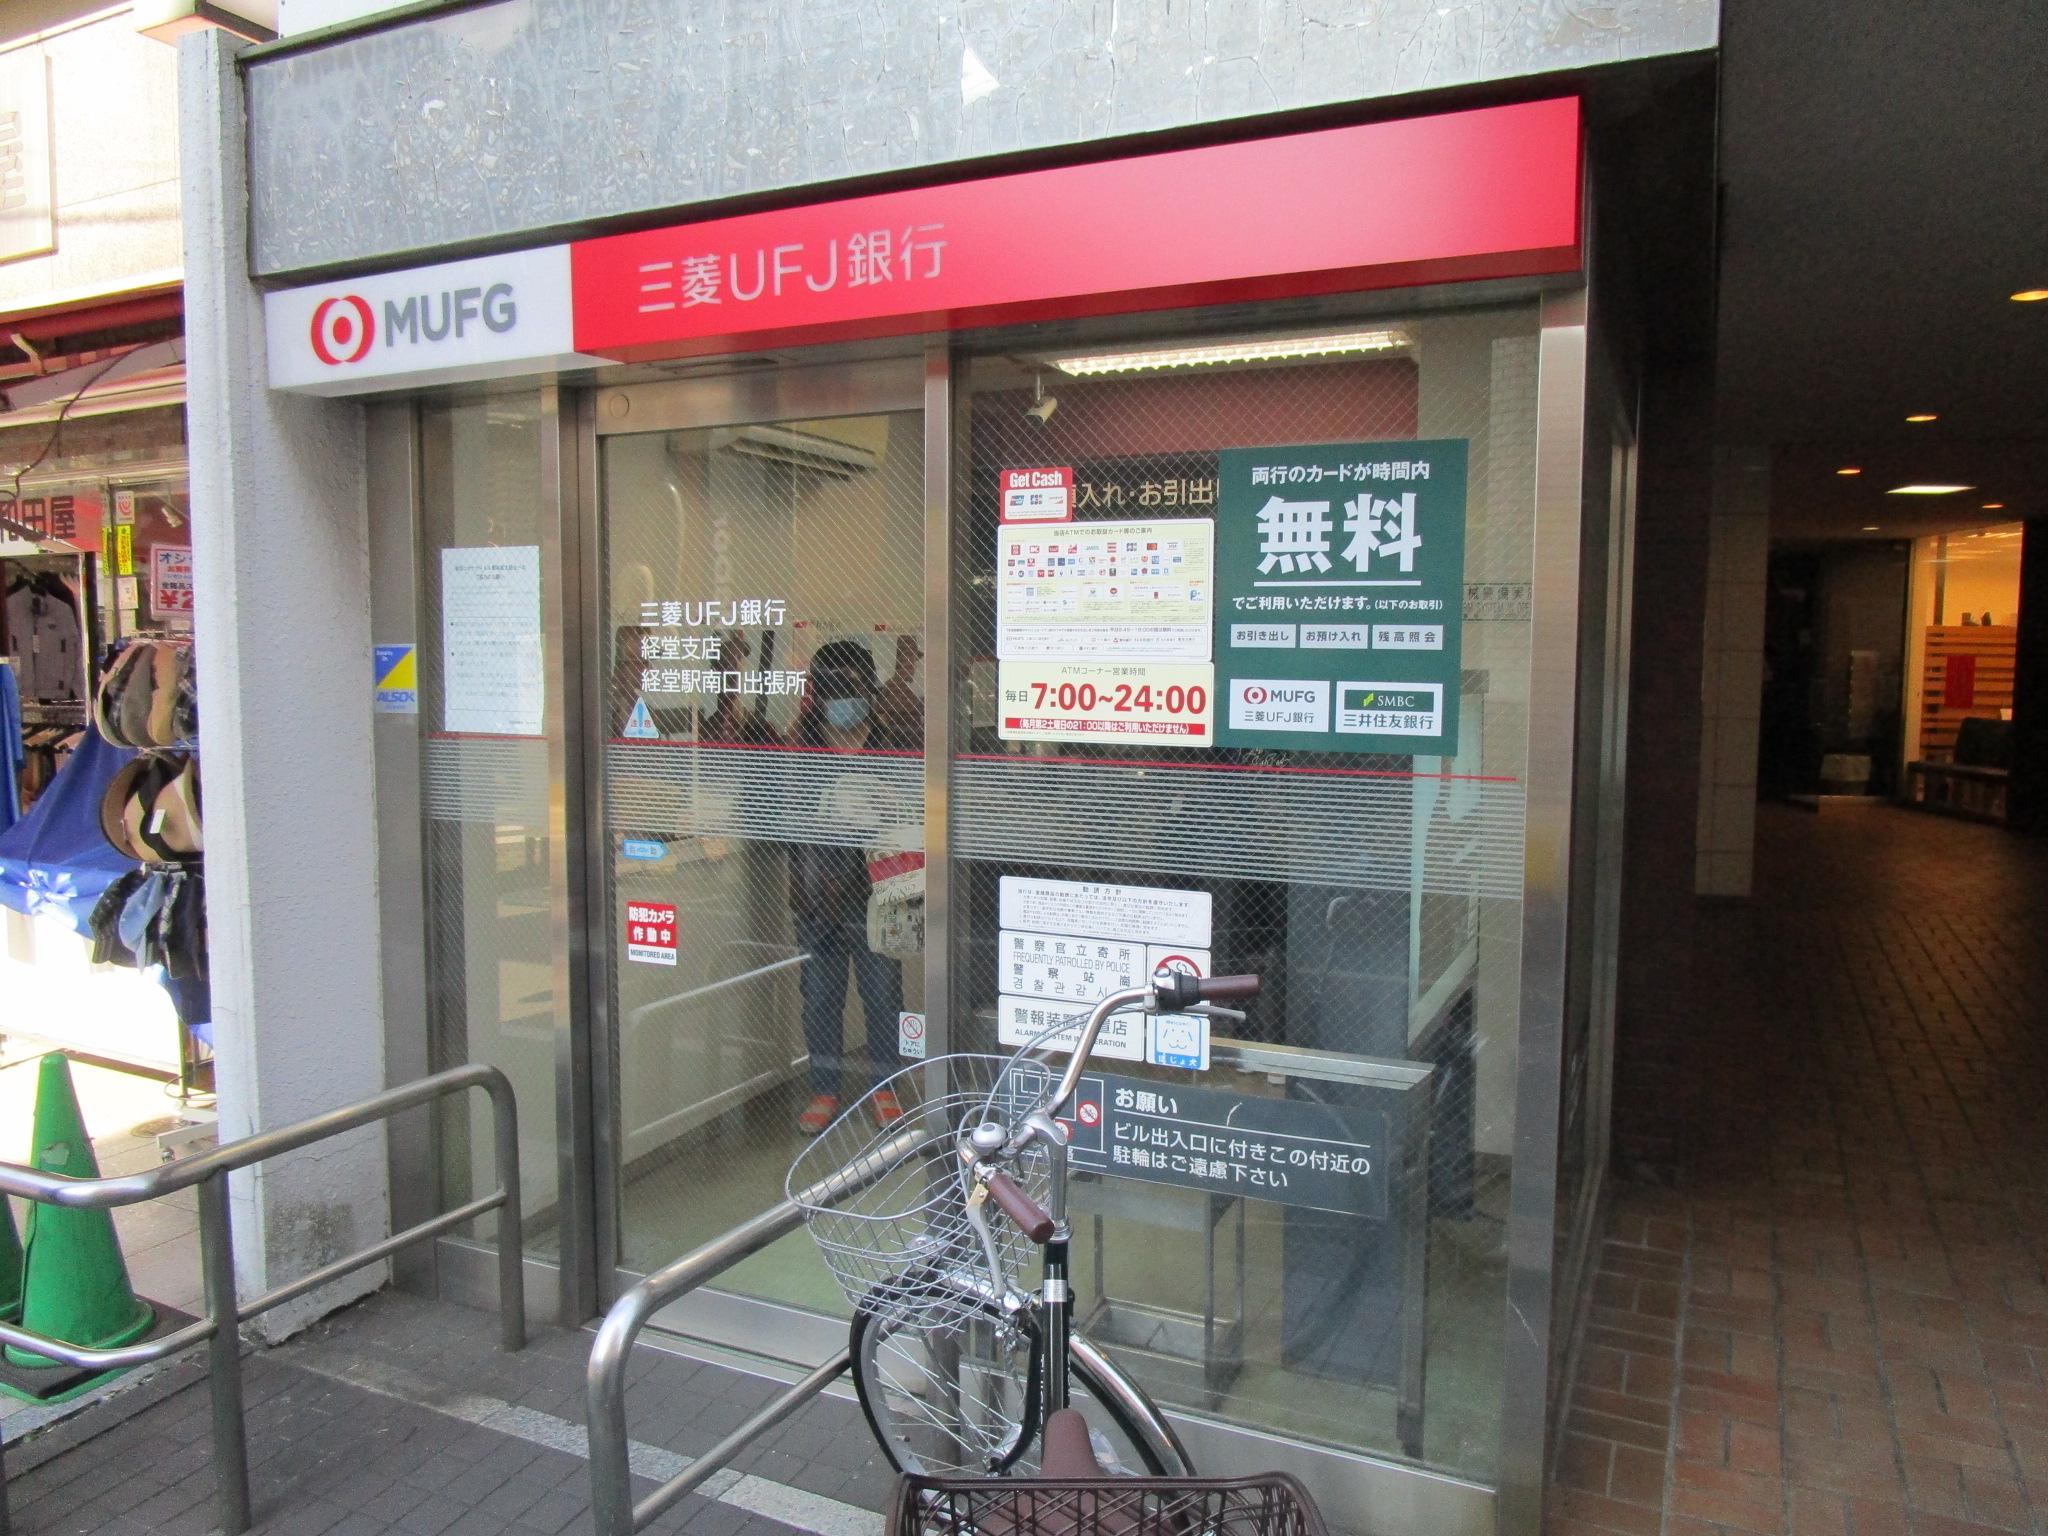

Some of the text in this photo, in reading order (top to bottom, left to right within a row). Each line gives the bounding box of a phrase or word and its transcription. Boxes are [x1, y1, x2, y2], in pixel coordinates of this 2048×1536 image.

[638, 223, 947, 313] 三菱UFJ銀行
[385, 283, 516, 346] MUFG
[1010, 470, 1062, 488] Get Cash
[1252, 461, 1430, 485] 両行のカードが時間内
[1072, 478, 1219, 508] 入れ・お引出
[1256, 492, 1422, 575] 無料
[159, 552, 192, 564] オシ
[640, 598, 786, 627] 三菱UFJ銀行
[1232, 597, 1371, 610] でご利用いただけます。
[1236, 631, 1289, 641] お引き出し
[1305, 631, 1361, 642] お預け入れ
[1378, 631, 1436, 643] 残高照会
[640, 635, 721, 660] 経堂支店
[641, 669, 807, 695] 経堂駅南口出張所
[1061, 667, 1146, 676] ATMコーナー営業時間
[1005, 682, 1206, 714] 毎日 7:00~24:00
[1270, 690, 1315, 702] MUFG
[1377, 695, 1414, 707] SMBC
[1244, 711, 1314, 724] 三菱UFJ銀行
[1343, 714, 1433, 730] 三井住友銀行
[629, 906, 674, 924] 防犯カメラ
[633, 926, 671, 944] 作動中
[630, 949, 660, 959] MONITORED
[1014, 937, 1130, 960] 警察官立寄所
[1013, 951, 1130, 974] FREQUENTLY PATROLLED BY POLICE
[1013, 977, 1108, 998] 경찰관감시
[1014, 1008, 1127, 1036] 警報装置置店
[1095, 1039, 1126, 1048] ERATION
[1115, 1087, 1178, 1115] お願い
[1114, 1121, 1370, 1176] ビル出入口に付きこの付近の
[1113, 1145, 1288, 1188] 駐輪はご遠慮下さい
